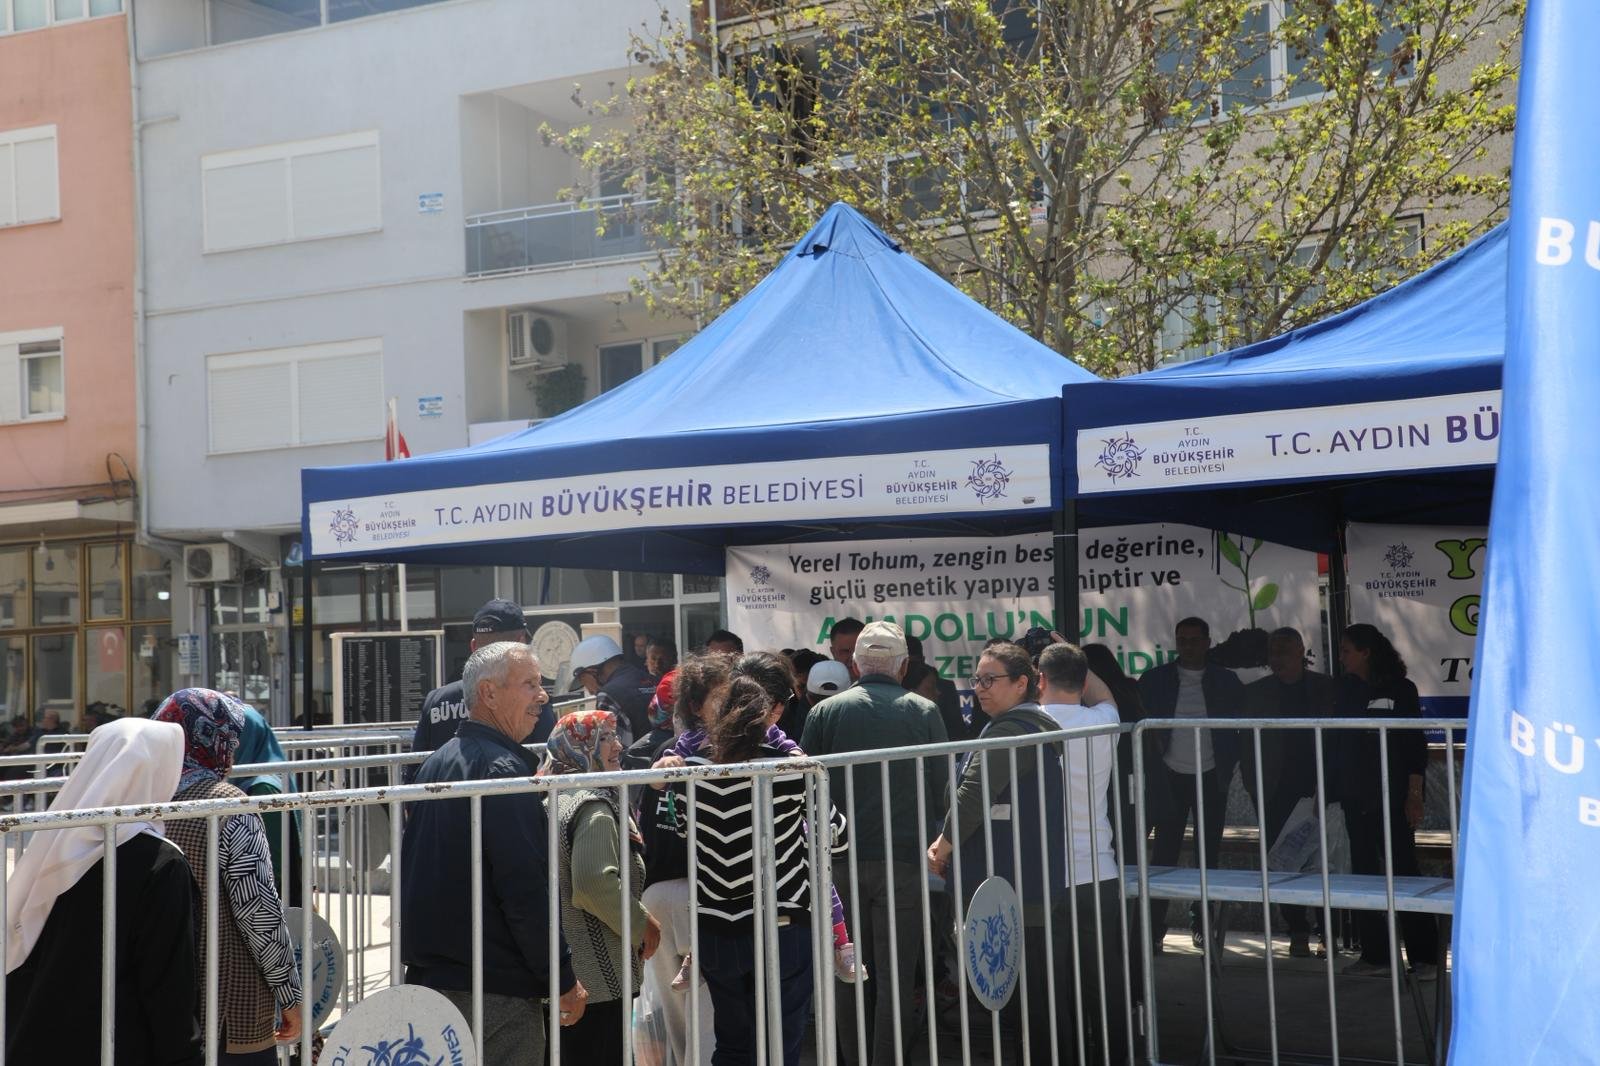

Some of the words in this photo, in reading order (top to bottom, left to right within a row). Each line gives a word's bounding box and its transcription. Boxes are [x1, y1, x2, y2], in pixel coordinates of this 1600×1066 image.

[1178, 438, 1210, 448] AYDIN
[1265, 432, 1321, 457] T.C.
[1329, 423, 1430, 454] AYDIN
[1153, 447, 1235, 464] BÜYÜKŞEHİR
[908, 470, 936, 479] AYDIN
[1164, 463, 1225, 476] BELEDİYESİ
[886, 480, 958, 493] BÜYÜKŞEHİR
[434, 507, 469, 526] T.C.
[472, 501, 534, 525] AYDIN
[541, 478, 712, 518] BÜYÜKŞEHİR
[723, 474, 864, 505] BELEDİYESİ
[895, 493, 949, 504] BELEDİYESİ
[365, 518, 417, 532] BÜYÜKŞEHİR
[789, 552, 841, 574] Yerel
[849, 551, 926, 572] Tohum,
[933, 545, 1008, 572] zengin
[1085, 535, 1204, 564] değerine,
[809, 579, 867, 606] güçlü
[873, 575, 956, 603] genetik
[964, 575, 1040, 600] yapıya
[1151, 569, 1181, 587] ve
[1366, 577, 1437, 590] BÜYÜKŞEHİR
